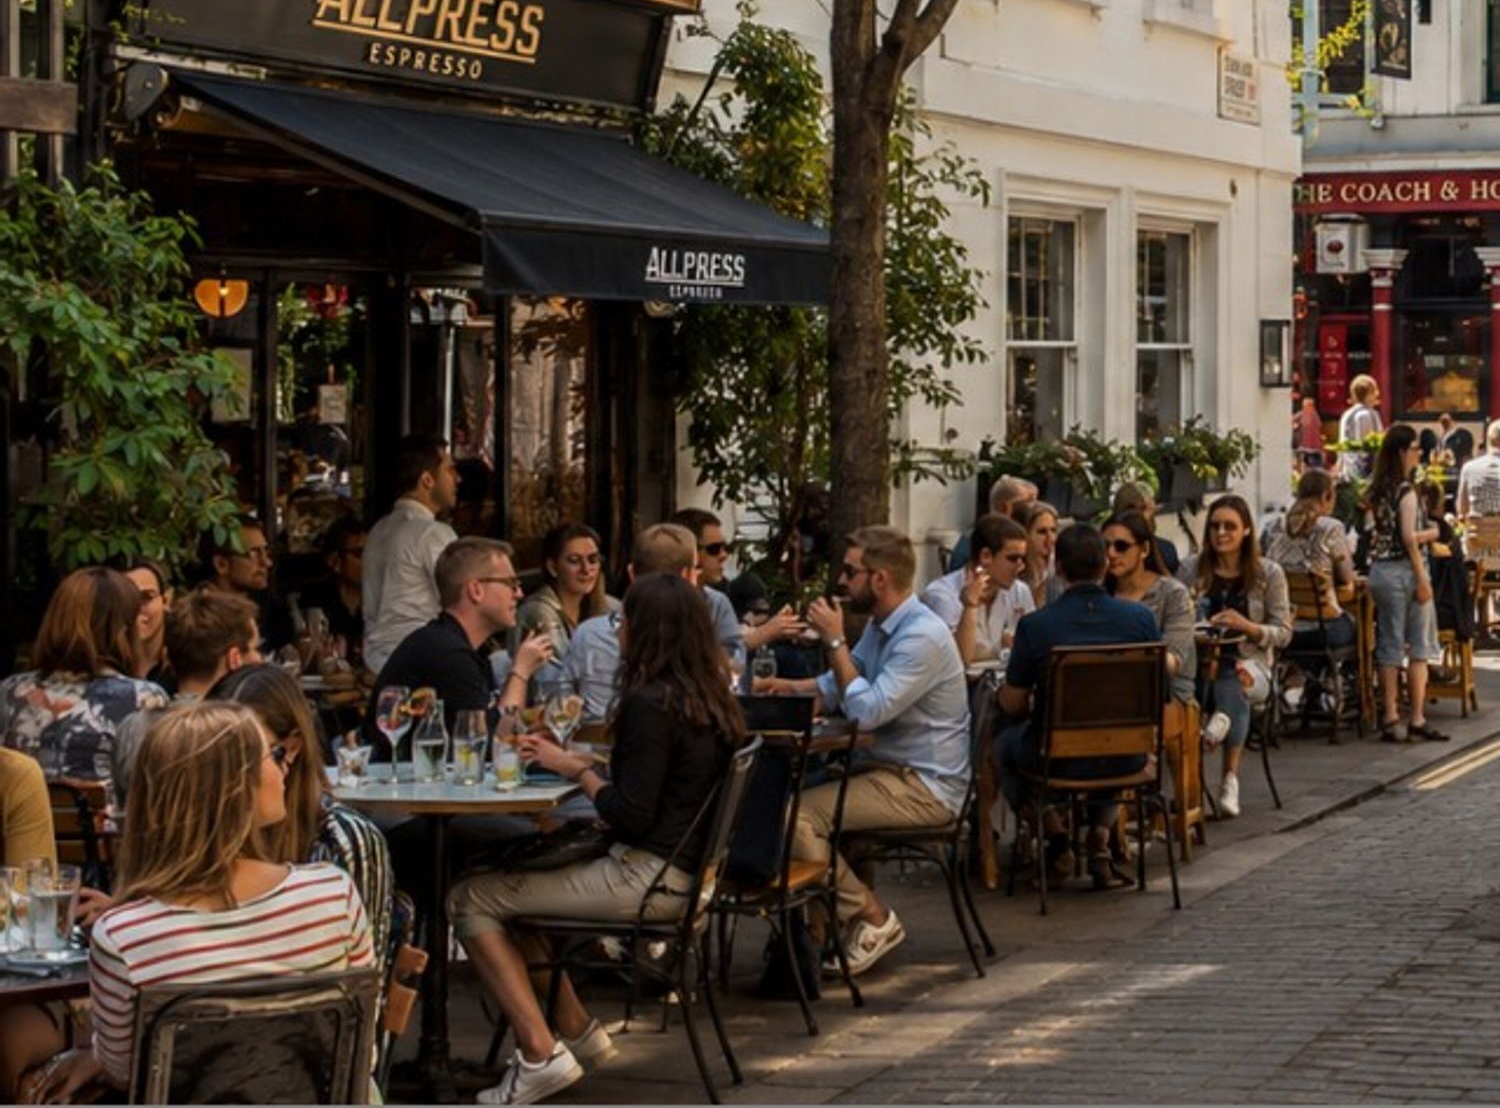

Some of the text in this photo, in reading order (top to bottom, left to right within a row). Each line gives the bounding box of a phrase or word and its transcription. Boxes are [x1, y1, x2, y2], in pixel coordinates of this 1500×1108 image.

[369, 42, 483, 80] ESPRESSO
[1340, 181, 1431, 202] COACH
[1440, 180, 1459, 200] &
[645, 246, 746, 281] ALLPRESS
